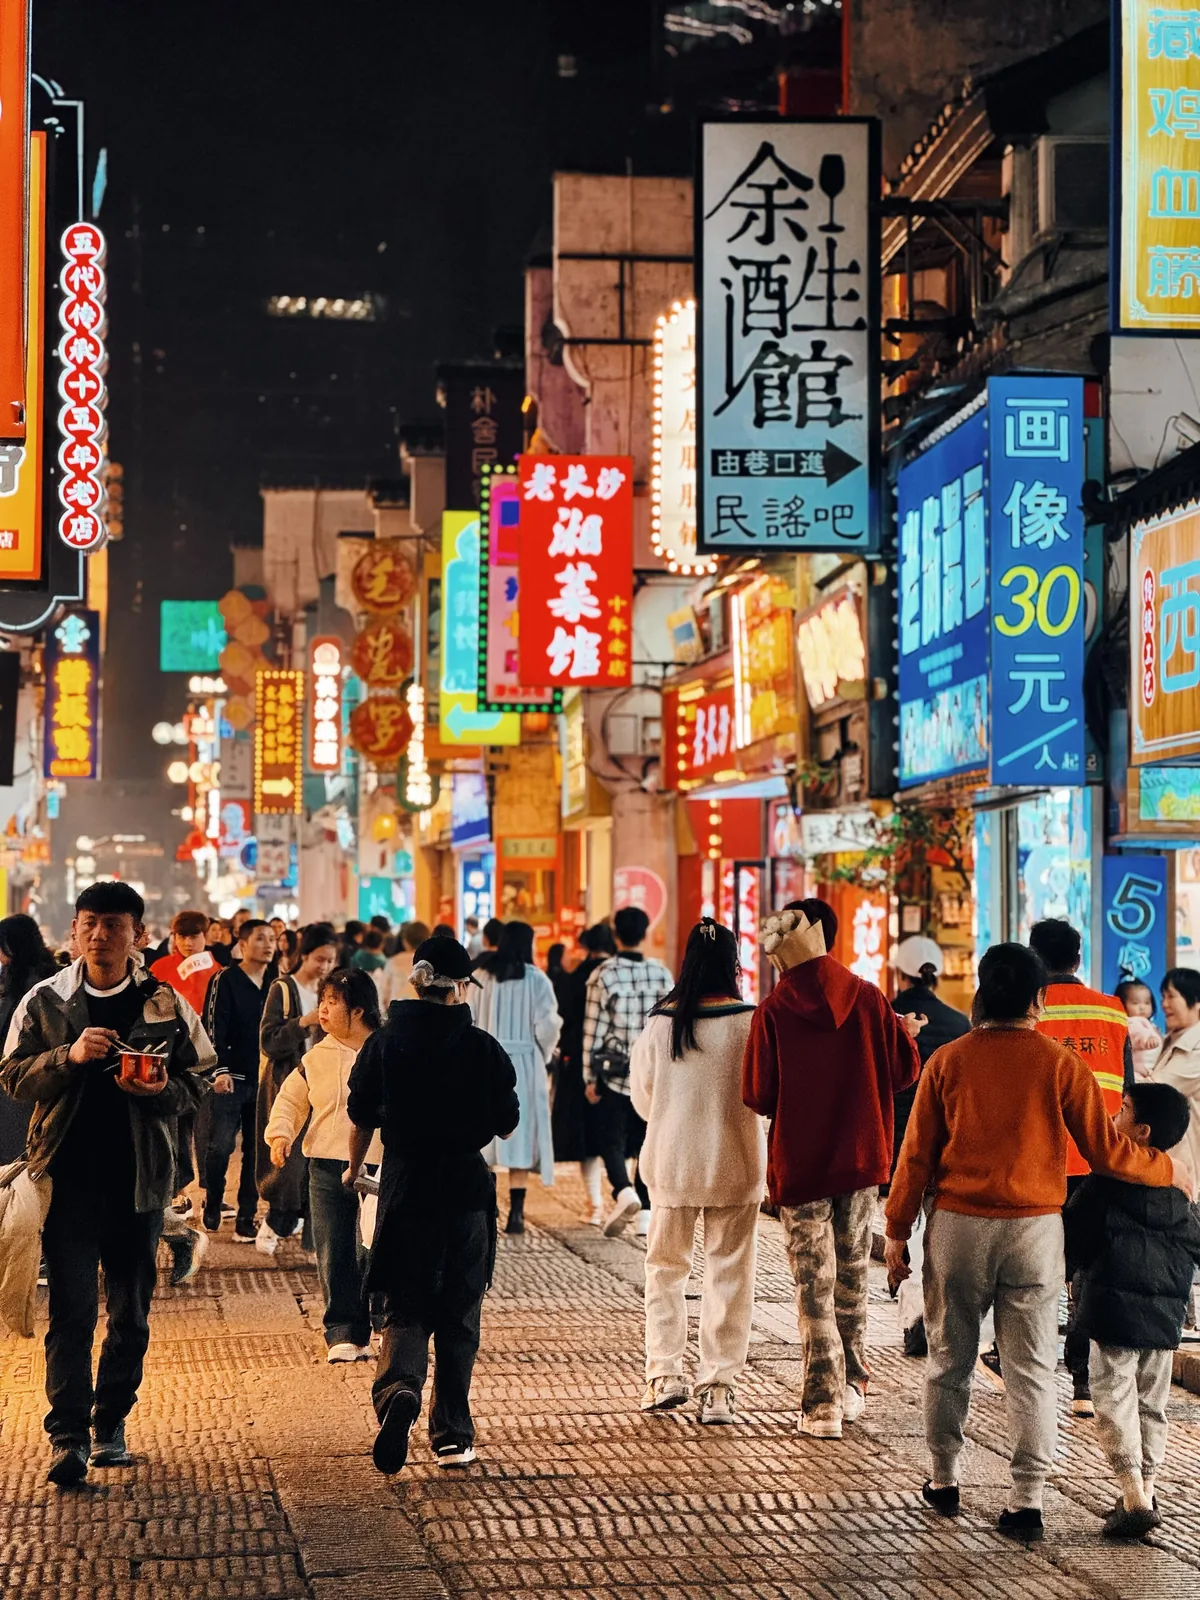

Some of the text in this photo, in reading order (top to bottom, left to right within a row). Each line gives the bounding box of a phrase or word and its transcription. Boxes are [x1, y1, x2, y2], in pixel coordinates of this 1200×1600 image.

[718, 451, 826, 475] 由巷口進
[523, 463, 625, 501] 老长沙
